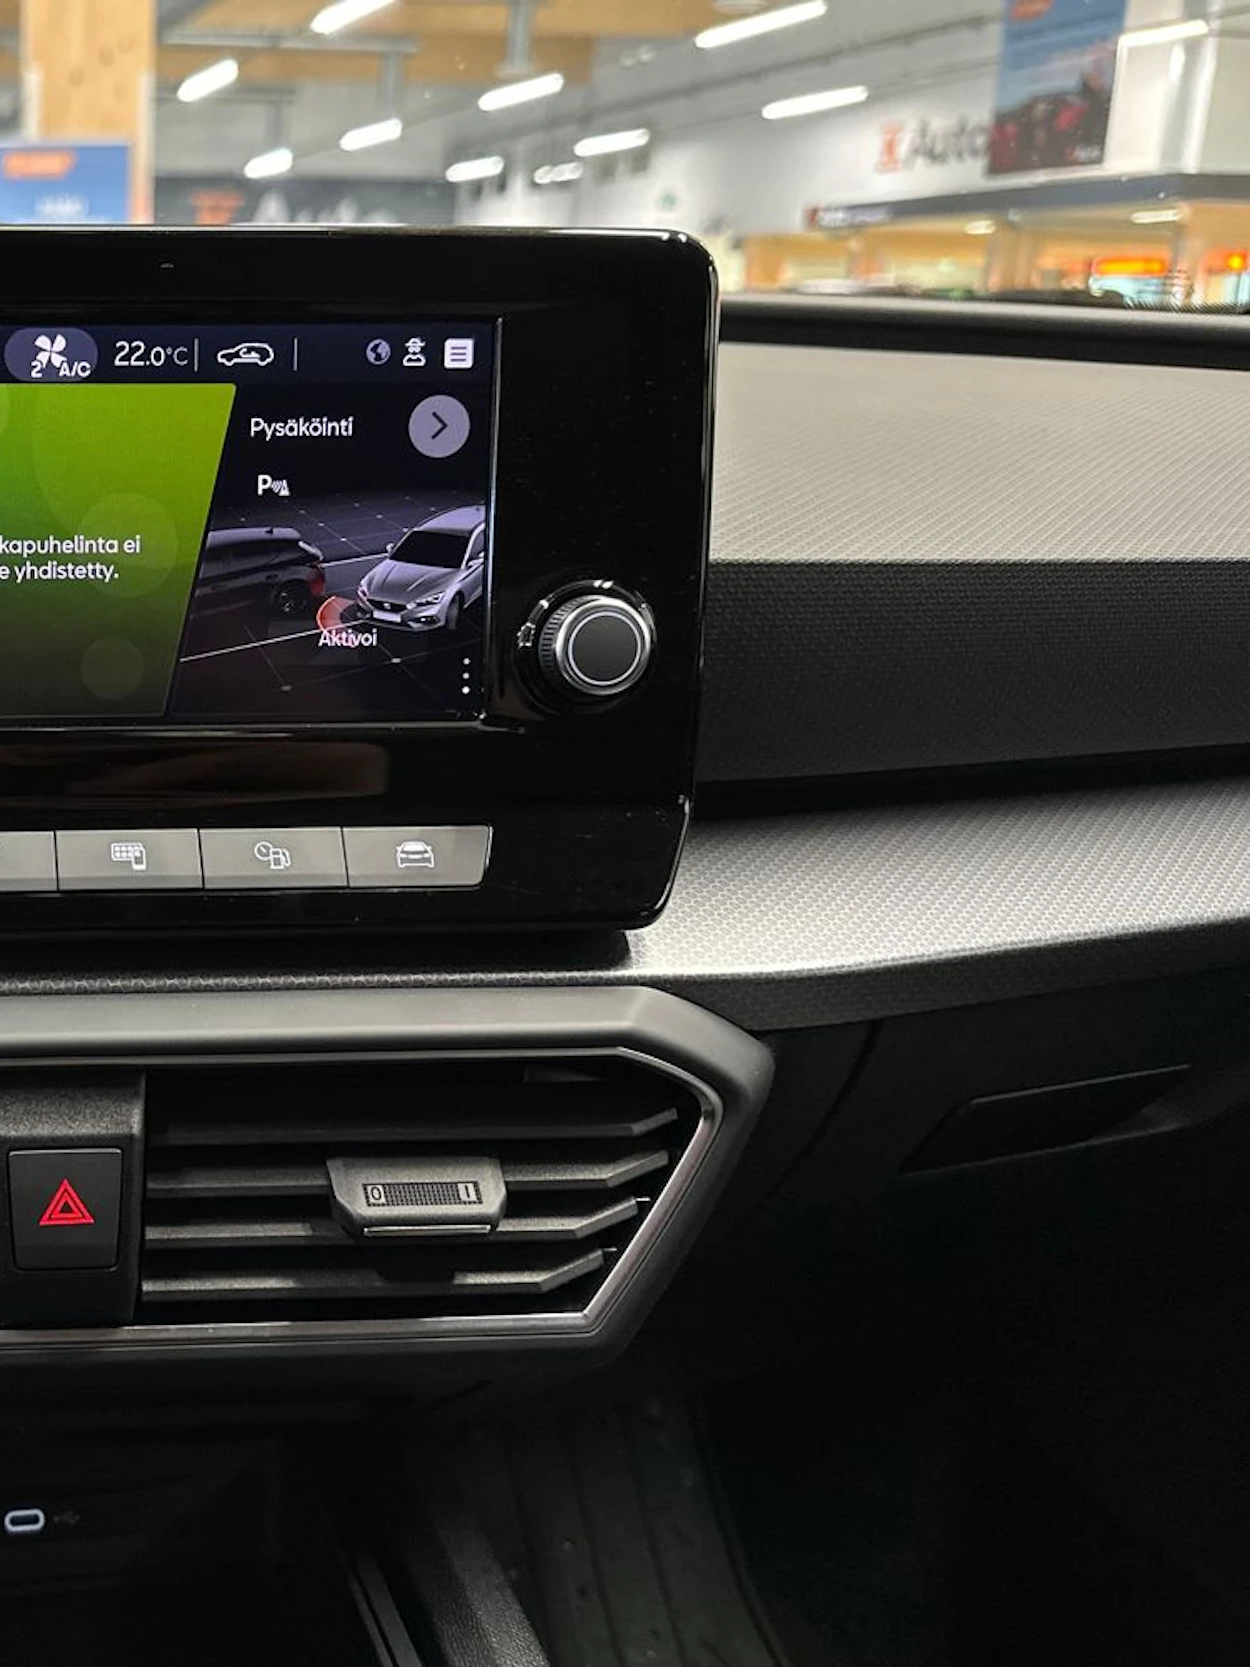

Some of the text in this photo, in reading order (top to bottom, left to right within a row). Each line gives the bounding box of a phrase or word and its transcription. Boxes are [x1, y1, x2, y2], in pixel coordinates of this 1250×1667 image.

[59, 362, 92, 378] A/C
[250, 416, 354, 442] Pysäköinti
[123, 534, 141, 554] ei
[14, 561, 119, 583] yhdistetty.
[317, 628, 378, 648] Aktivoi
